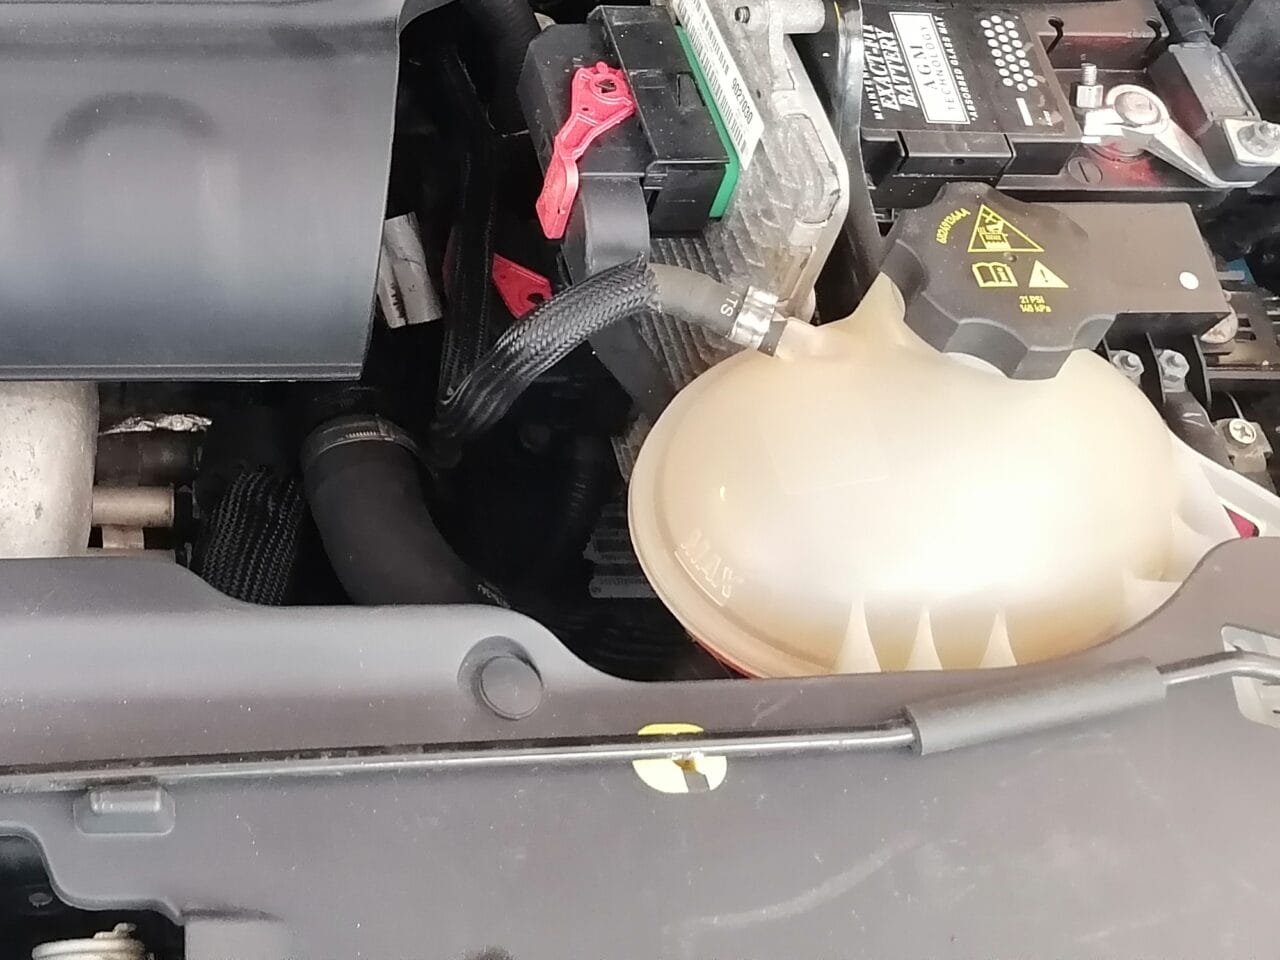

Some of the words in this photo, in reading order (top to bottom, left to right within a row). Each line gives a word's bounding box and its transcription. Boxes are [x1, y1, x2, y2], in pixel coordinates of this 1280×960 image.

[933, 15, 949, 35] MAT
[874, 26, 919, 108] BATTERY
[910, 44, 938, 90] AGM
[920, 26, 956, 110] TECHNOLOGY
[941, 36, 959, 66] GLASS
[731, 77, 754, 125] 9027030
[1018, 295, 1029, 303] 21
[1028, 295, 1045, 304] PSI
